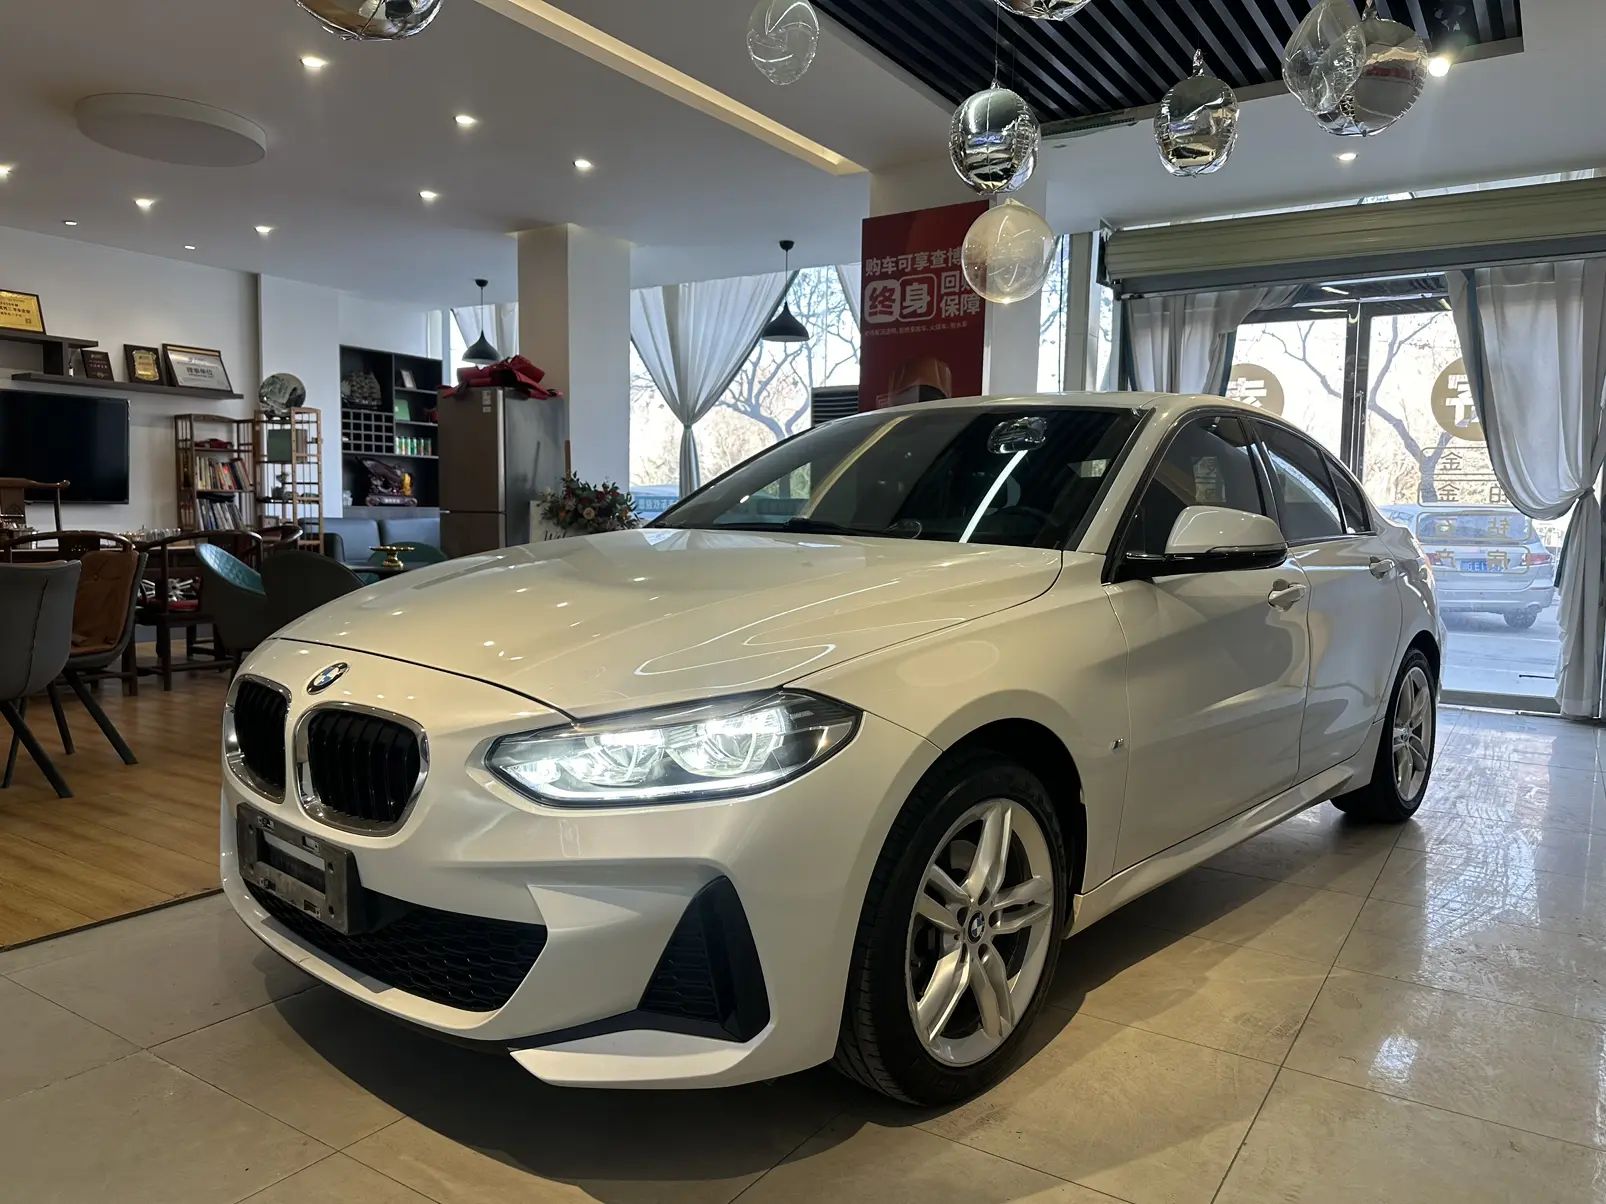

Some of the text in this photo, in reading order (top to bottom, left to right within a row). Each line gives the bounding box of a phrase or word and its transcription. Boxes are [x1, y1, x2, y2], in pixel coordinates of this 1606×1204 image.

[865, 247, 963, 277] 购车可享查博
[868, 282, 931, 317] 终身
[940, 294, 980, 318] 保障
